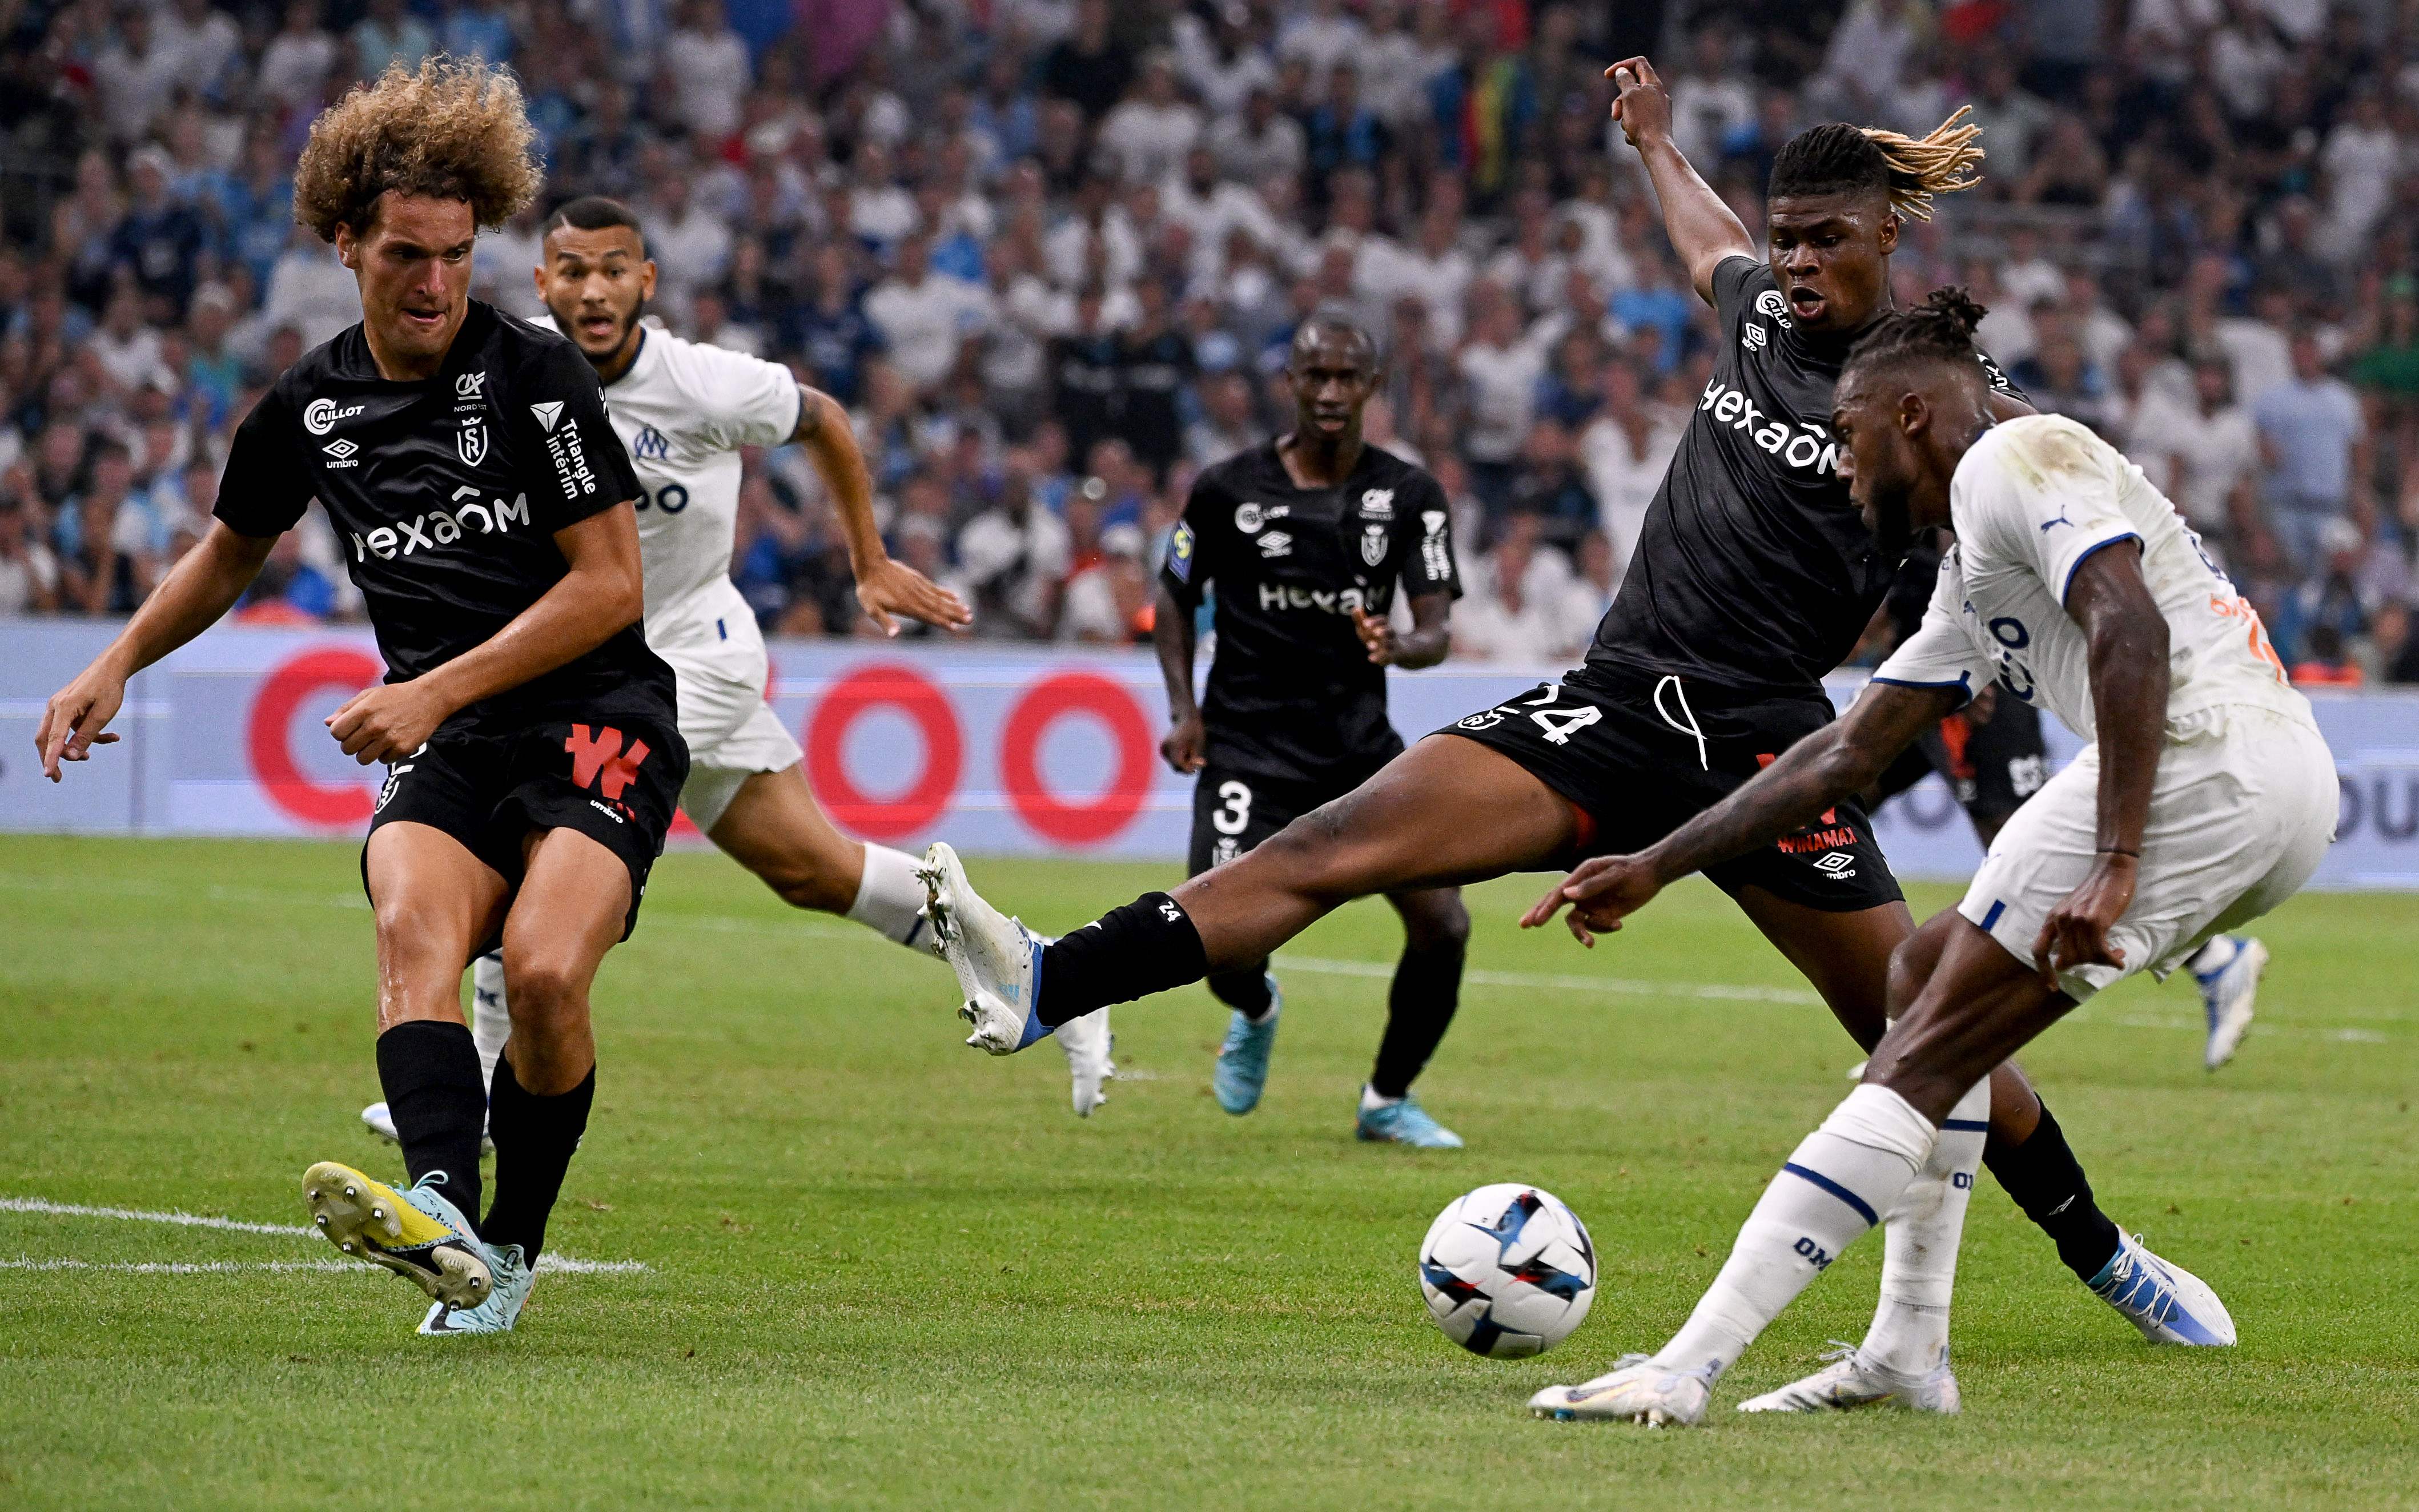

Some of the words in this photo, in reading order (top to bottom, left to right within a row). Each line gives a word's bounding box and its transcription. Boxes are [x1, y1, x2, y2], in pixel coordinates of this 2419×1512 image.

[304, 398, 365, 436] CAILLOT
[454, 404, 477, 412] NORD
[326, 459, 359, 469] umbro
[546, 434, 578, 500] intérim
[561, 419, 596, 494] Triangle
[589, 799, 624, 824] umbro
[1212, 781, 1252, 835] 3
[1778, 827, 1858, 854] WINAMAX
[1823, 869, 1856, 879] mbro
[1159, 900, 1181, 922] 24
[1794, 1236, 1834, 1272] OM
